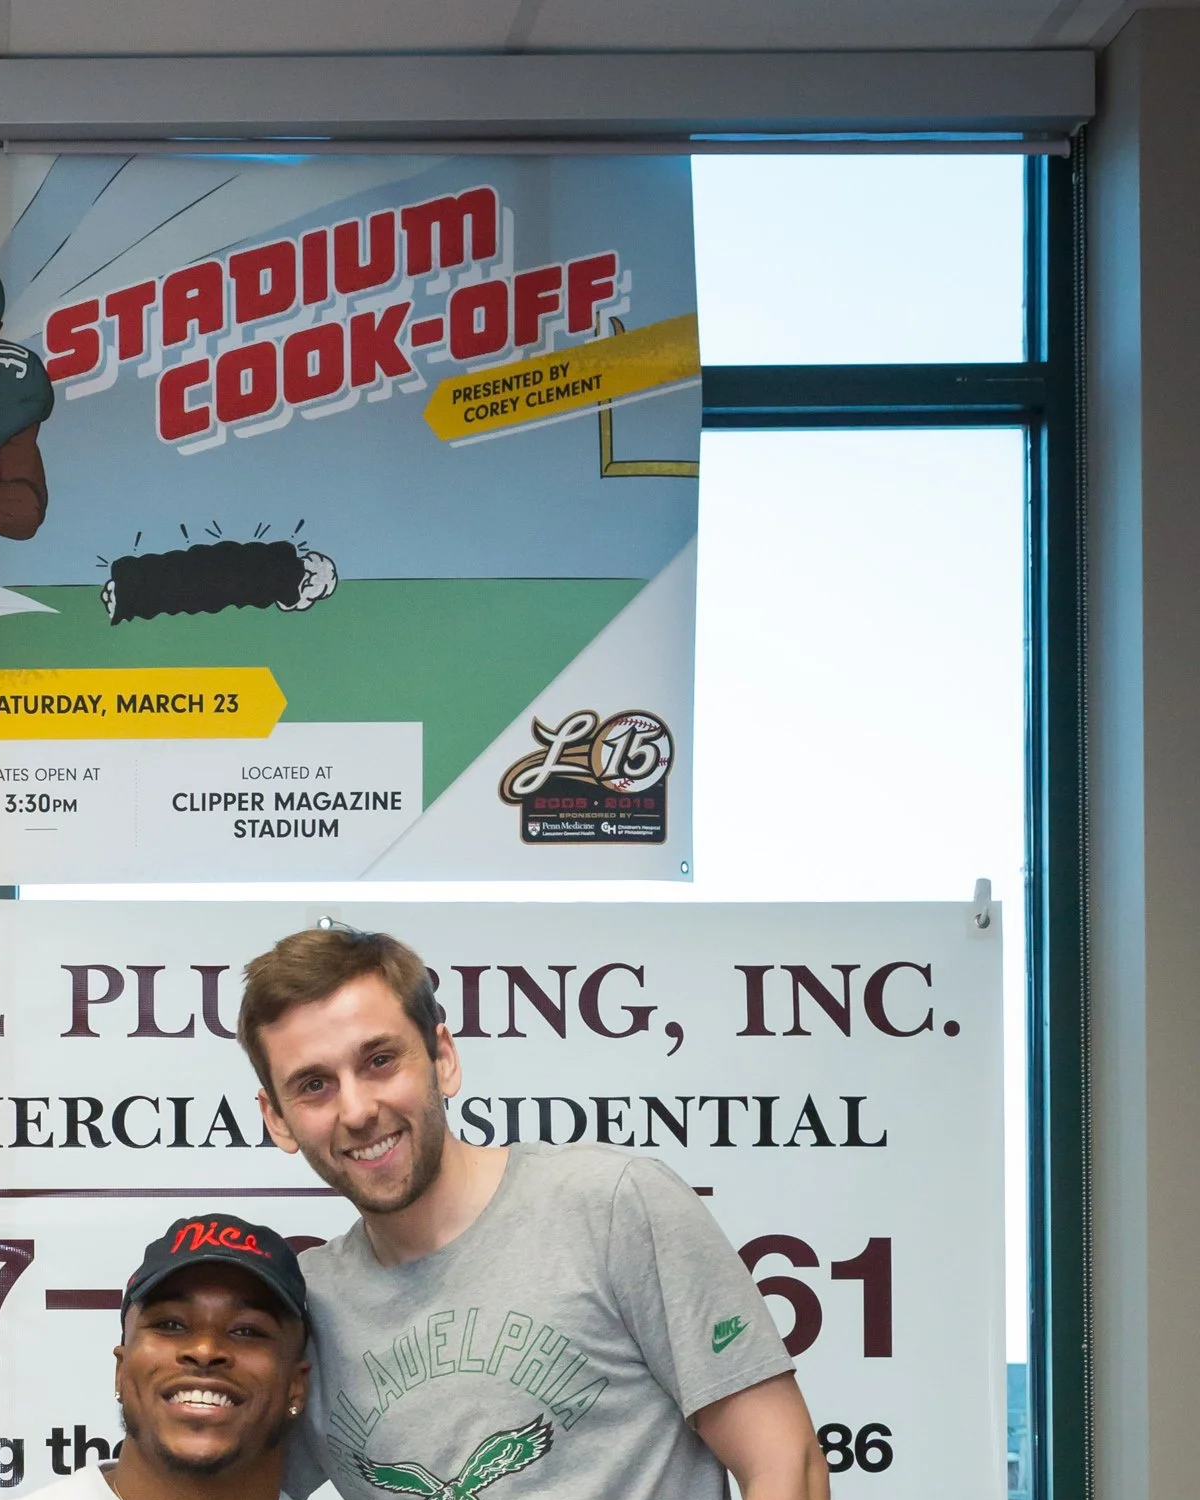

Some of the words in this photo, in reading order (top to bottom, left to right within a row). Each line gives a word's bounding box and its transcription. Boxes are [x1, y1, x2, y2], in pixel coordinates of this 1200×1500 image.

[44, 186, 498, 383] STADIUM
[158, 251, 617, 442] COOK-OFF
[452, 369, 543, 405] PRESENTED
[549, 361, 570, 381] BY
[464, 396, 520, 423] COREY
[526, 374, 603, 408] CLEMENT
[116, 694, 204, 714] MARCH
[213, 693, 239, 714] 23
[601, 725, 663, 779] 15
[34, 767, 78, 783] OPEN
[82, 767, 101, 782] AT
[241, 766, 311, 780] LOCATED
[315, 766, 334, 780] AT
[4, 793, 78, 814] 3:30PM
[171, 792, 265, 812] CLIPPER
[274, 791, 402, 811] MAGAZINE
[233, 819, 339, 839] STADIUM
[542, 821, 561, 831] Penn
[562, 821, 595, 831] Medicine
[60, 962, 685, 1057] PLUING,
[735, 961, 961, 1038] INC.
[443, 1093, 887, 1148] SIDENTIAL
